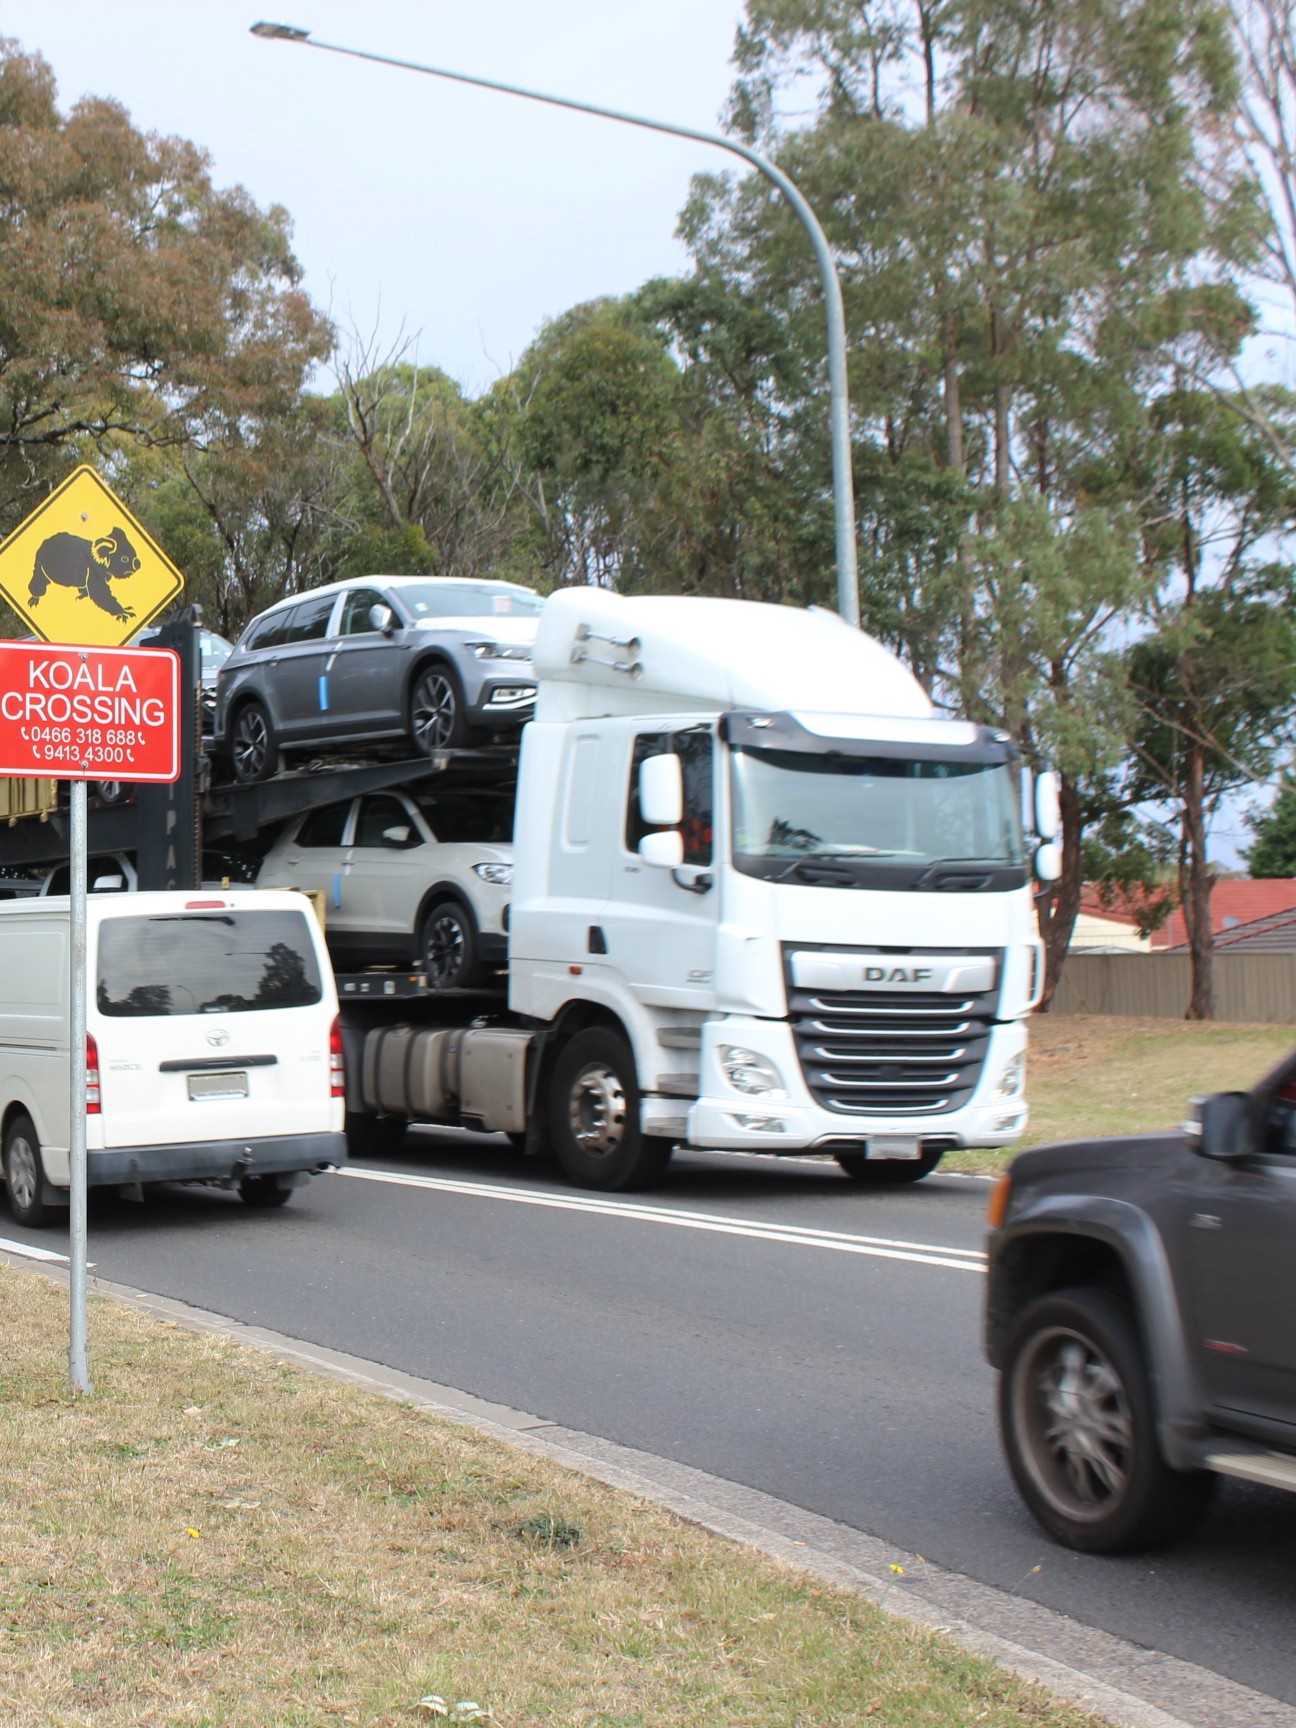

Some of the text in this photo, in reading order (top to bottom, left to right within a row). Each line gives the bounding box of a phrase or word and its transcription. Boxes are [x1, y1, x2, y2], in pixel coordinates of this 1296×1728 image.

[29, 660, 137, 693] KOALA
[1, 691, 165, 727] CROSSING
[30, 726, 135, 746] 0466 318 688
[44, 744, 124, 763] 9413 4300
[862, 967, 933, 983] DAF
